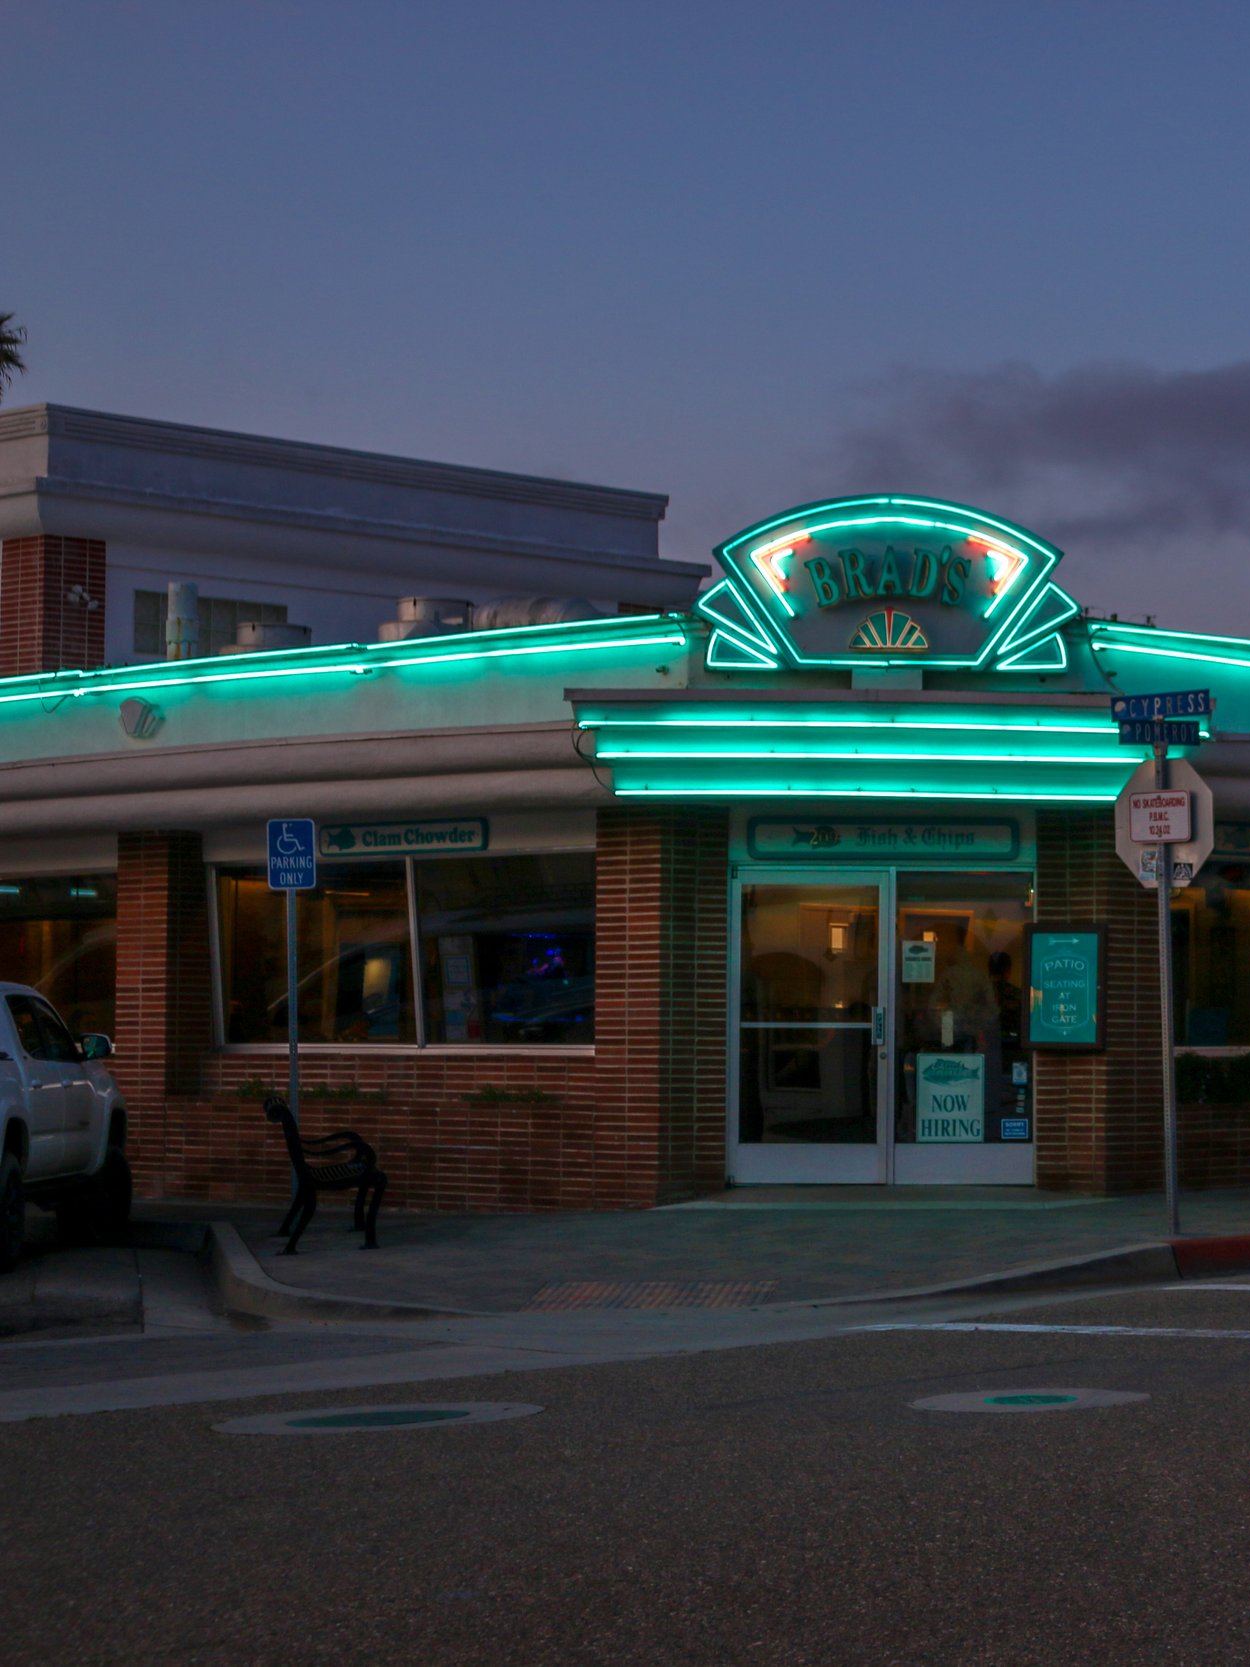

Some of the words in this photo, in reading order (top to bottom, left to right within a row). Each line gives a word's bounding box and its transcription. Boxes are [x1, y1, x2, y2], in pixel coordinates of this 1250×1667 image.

[804, 545, 972, 608] BRAD'S
[1129, 692, 1206, 718] CYPRESS
[1135, 722, 1197, 742] POMEROY
[1132, 799, 1141, 809] NO
[1143, 796, 1185, 808] SKATEBOARDING
[362, 829, 401, 847] Clam
[404, 826, 477, 846] Chowder
[856, 826, 898, 849] Fish
[903, 826, 918, 846] &
[921, 825, 976, 849] Chips
[271, 856, 312, 869] PARKING
[279, 871, 304, 885] ONLY
[1044, 958, 1085, 972] PATIO
[1043, 980, 1086, 989] SEATING
[1058, 991, 1071, 1000] AT
[1052, 1003, 1077, 1012] IRON
[1051, 1015, 1078, 1024] GATE
[931, 1094, 970, 1113] NOW
[921, 1118, 981, 1138] HIRING
